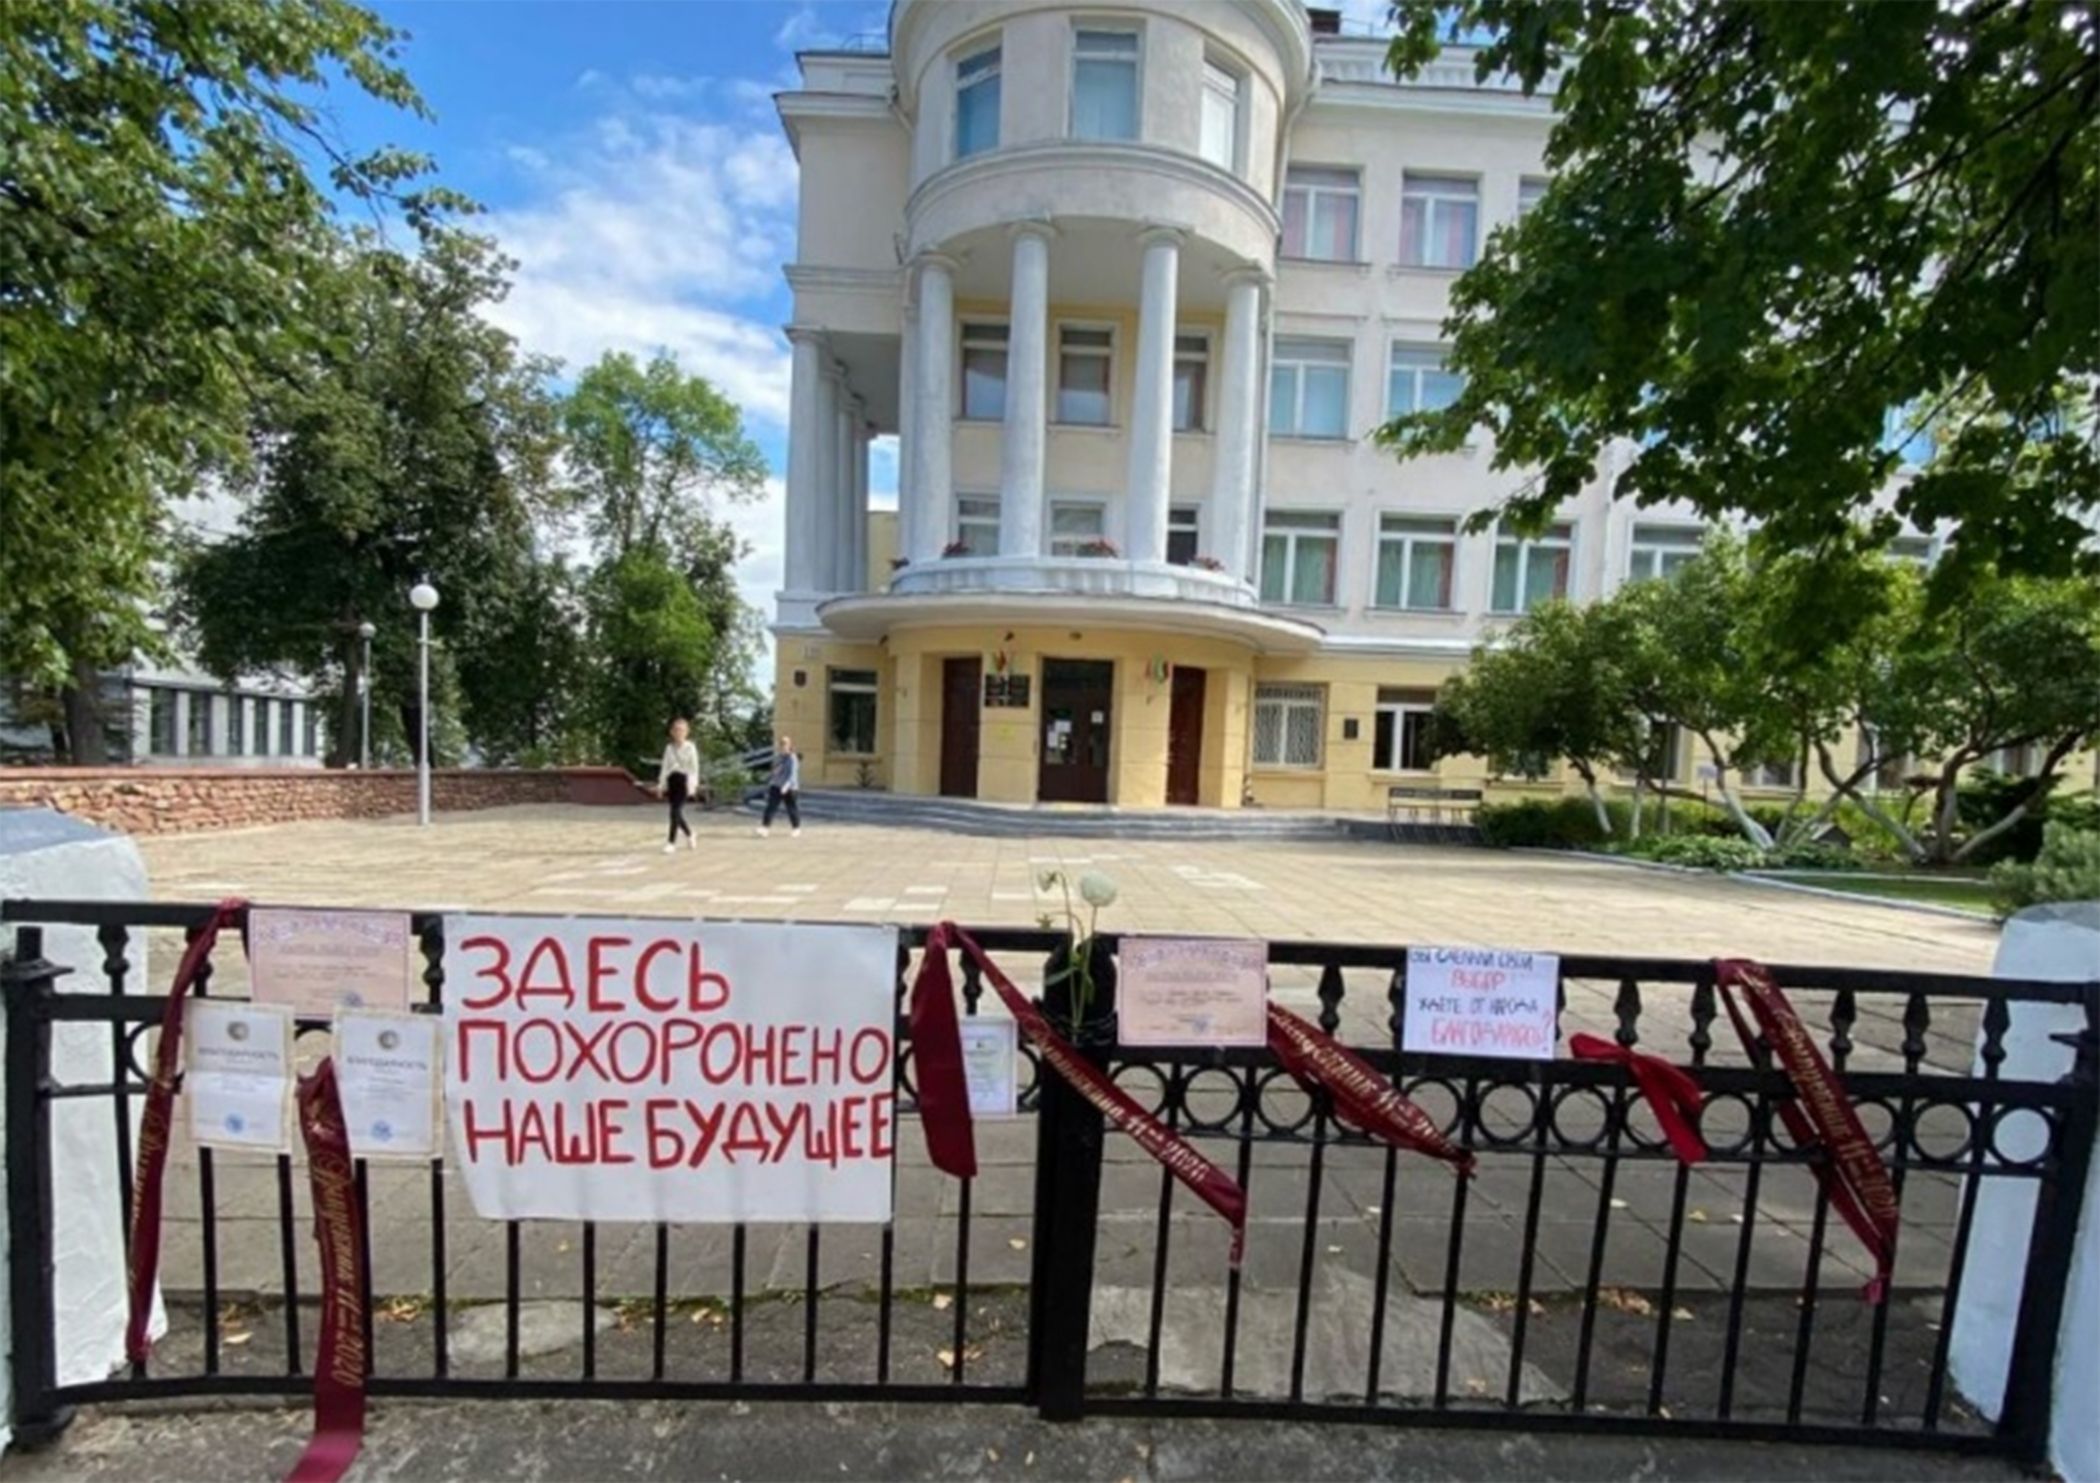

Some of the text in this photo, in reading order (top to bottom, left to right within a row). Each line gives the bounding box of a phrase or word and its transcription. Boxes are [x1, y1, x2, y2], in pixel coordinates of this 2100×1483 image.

[459, 937, 730, 1012] ЗДЕСЬ
[458, 1018, 889, 1085] ПОХОРОНЕНО
[464, 1091, 895, 1169] НАШЕ БУДУЩЕЕ
